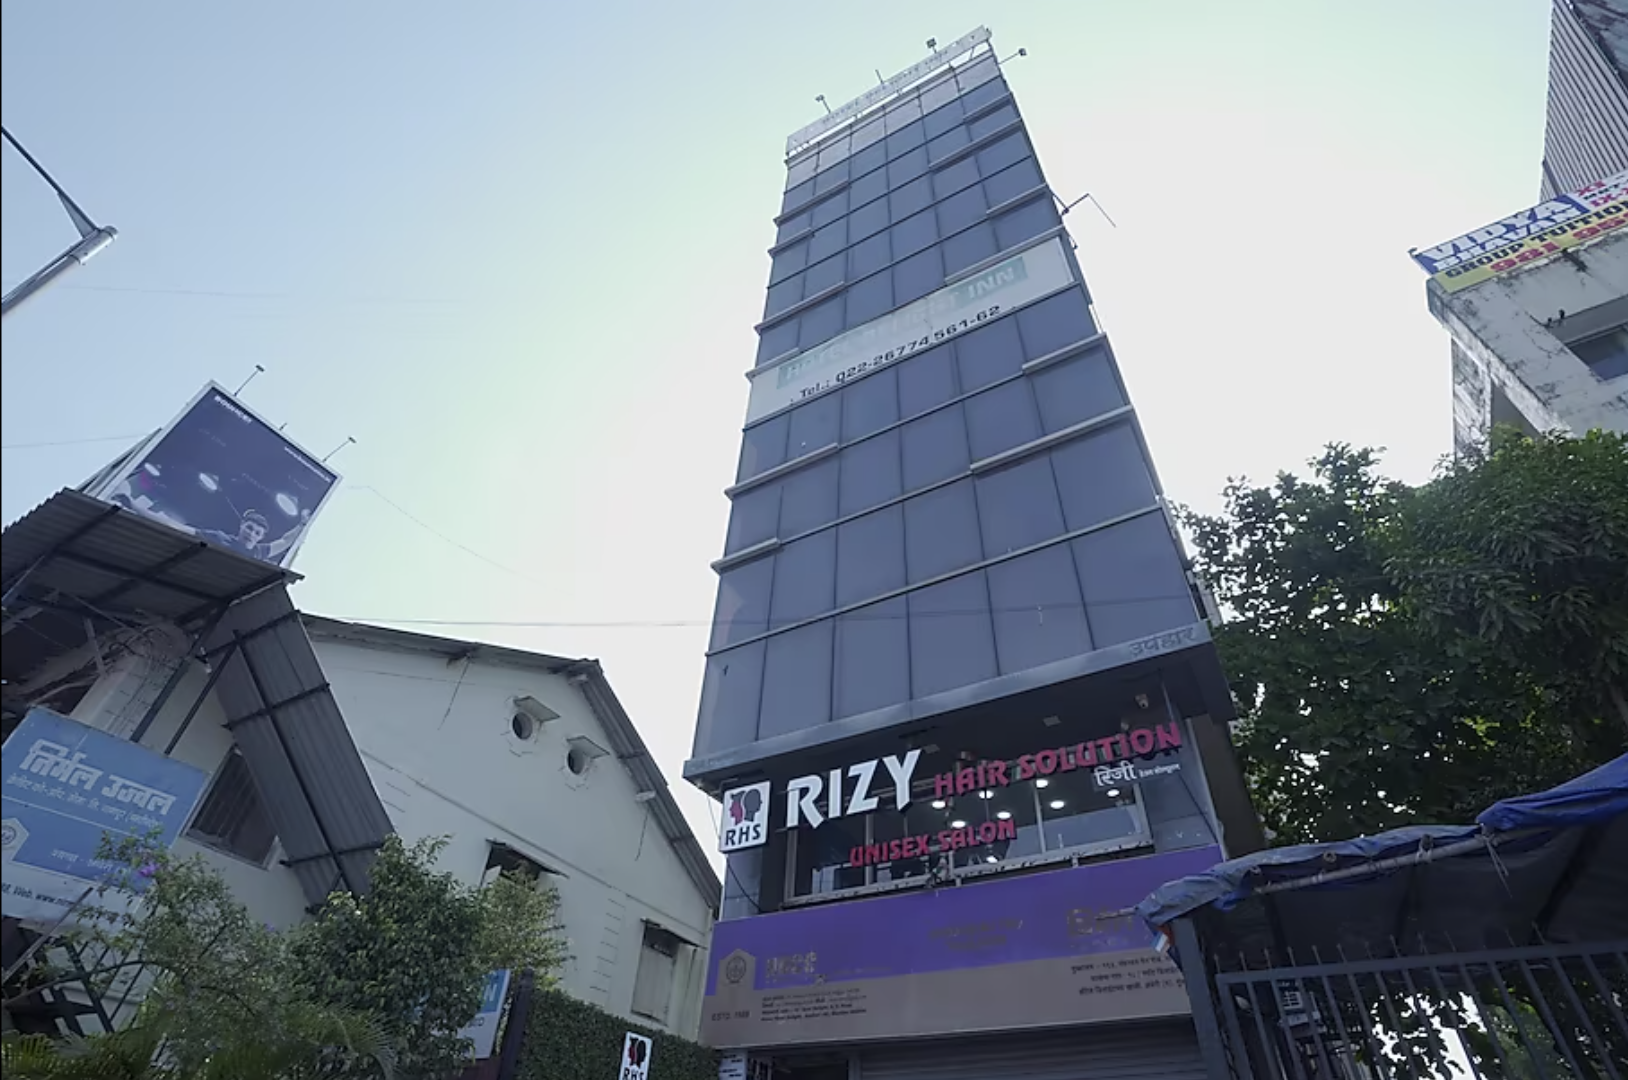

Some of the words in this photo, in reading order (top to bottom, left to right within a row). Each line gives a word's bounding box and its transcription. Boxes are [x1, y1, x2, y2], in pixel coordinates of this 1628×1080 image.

[1421, 200, 1573, 261] VIDYA
[1433, 207, 1582, 271] BHAVAN
[967, 266, 1015, 297] INN
[1445, 242, 1524, 278] GROUP
[19, 739, 104, 790] निर्मल
[724, 823, 762, 846] RHS
[787, 749, 921, 829] RIZY
[934, 760, 1009, 799] HAIR
[1015, 722, 1182, 780] SOLUTION
[850, 833, 930, 867] UNISEX
[938, 819, 1016, 854] SALON
